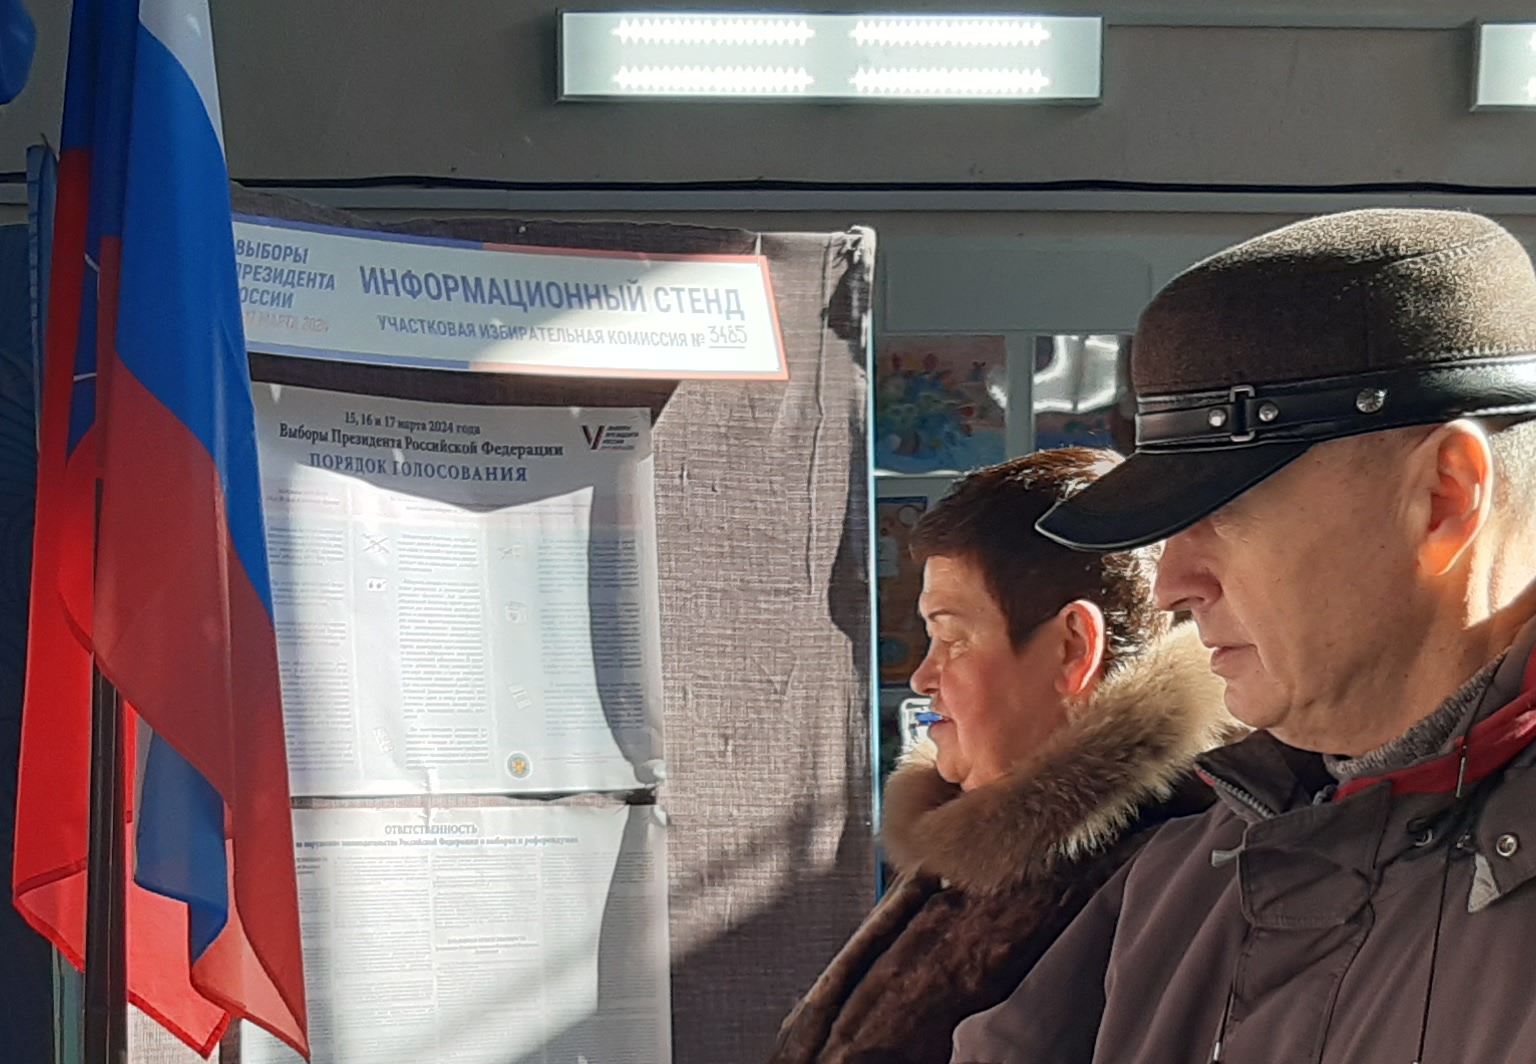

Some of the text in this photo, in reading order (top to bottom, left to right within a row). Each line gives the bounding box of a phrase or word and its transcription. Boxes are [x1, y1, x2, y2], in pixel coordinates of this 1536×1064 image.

[235, 239, 309, 264] ВЫБОРЫ
[239, 286, 294, 309] ОССИИ
[359, 265, 746, 321] ИНФОРМАЦИОННЫЙ СТЕНД
[377, 313, 476, 338] УЧАСТКОВАЯ
[479, 322, 605, 344] ИЗБИРАТЕЛЬНАЯ
[607, 329, 688, 347] КОМИССИЯ
[361, 413, 372, 426] 16
[384, 415, 395, 428] 17
[428, 420, 453, 433] 2024
[279, 422, 564, 459] Выборы Президента Российской Федерации
[309, 452, 528, 482] ПОРЯДОК ГОЛОСОВАНИЯ
